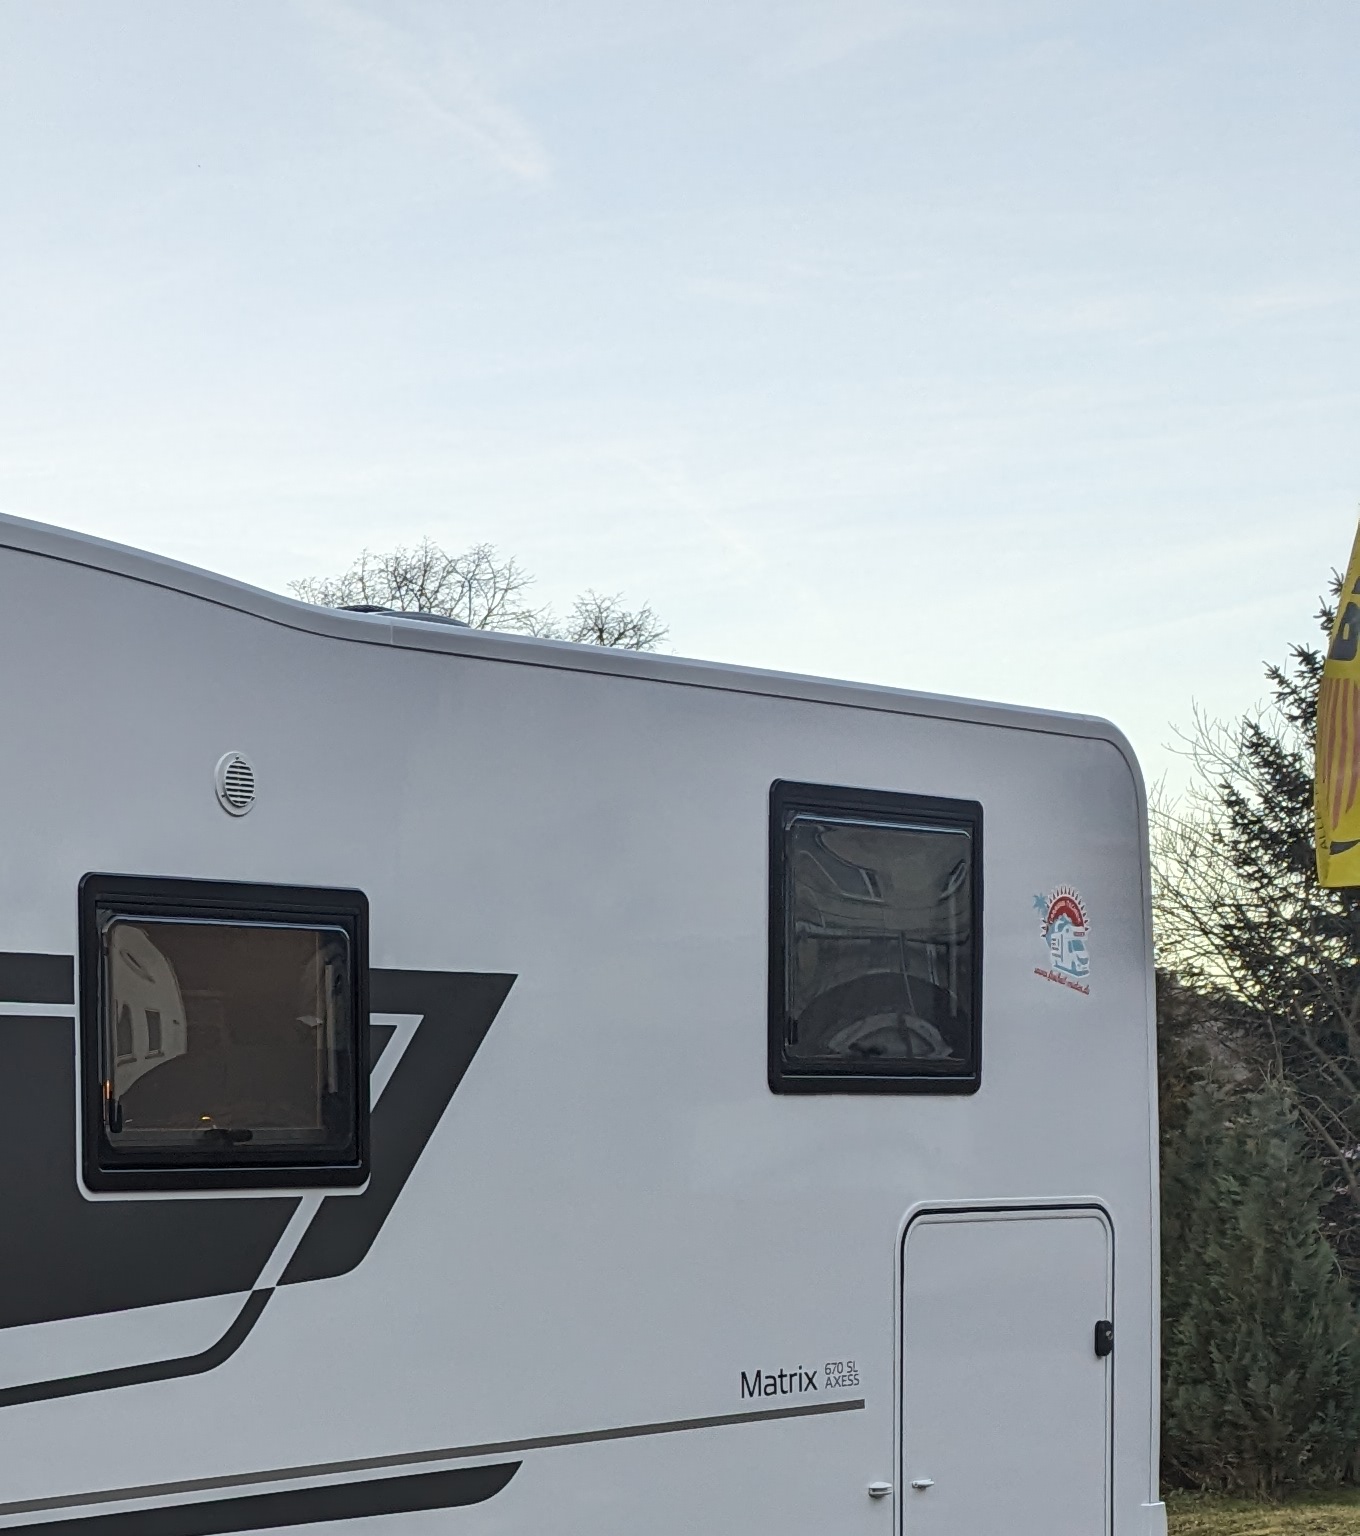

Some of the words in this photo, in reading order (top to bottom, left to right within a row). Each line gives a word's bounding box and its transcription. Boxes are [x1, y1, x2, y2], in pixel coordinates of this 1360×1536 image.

[740, 1365, 818, 1399] Matrix
[824, 1362, 843, 1375] 670
[846, 1360, 859, 1374] SL
[824, 1373, 860, 1389] AXESS
